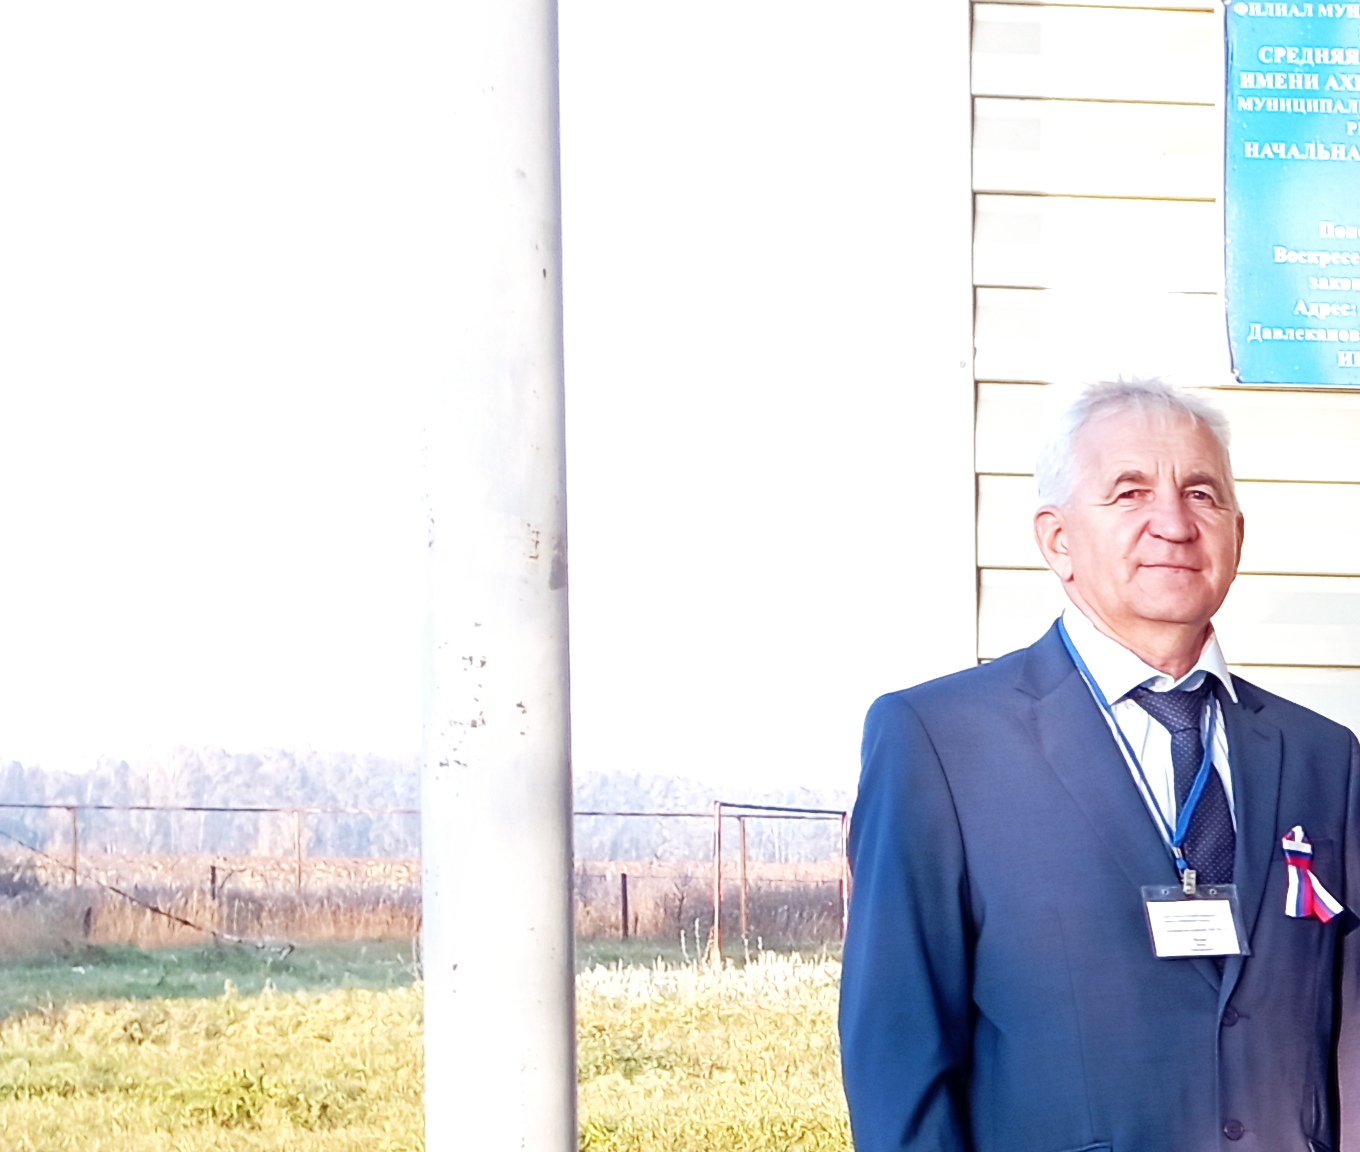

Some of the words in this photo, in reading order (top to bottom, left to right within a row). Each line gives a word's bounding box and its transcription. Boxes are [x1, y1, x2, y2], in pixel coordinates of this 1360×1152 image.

[1233, 1, 1314, 17] ФИЛИАЛ
[1258, 46, 1360, 66] СРЕДНЯЯ
[1240, 72, 1319, 90] ИМЕНИ
[1293, 300, 1357, 319] Адрес:
